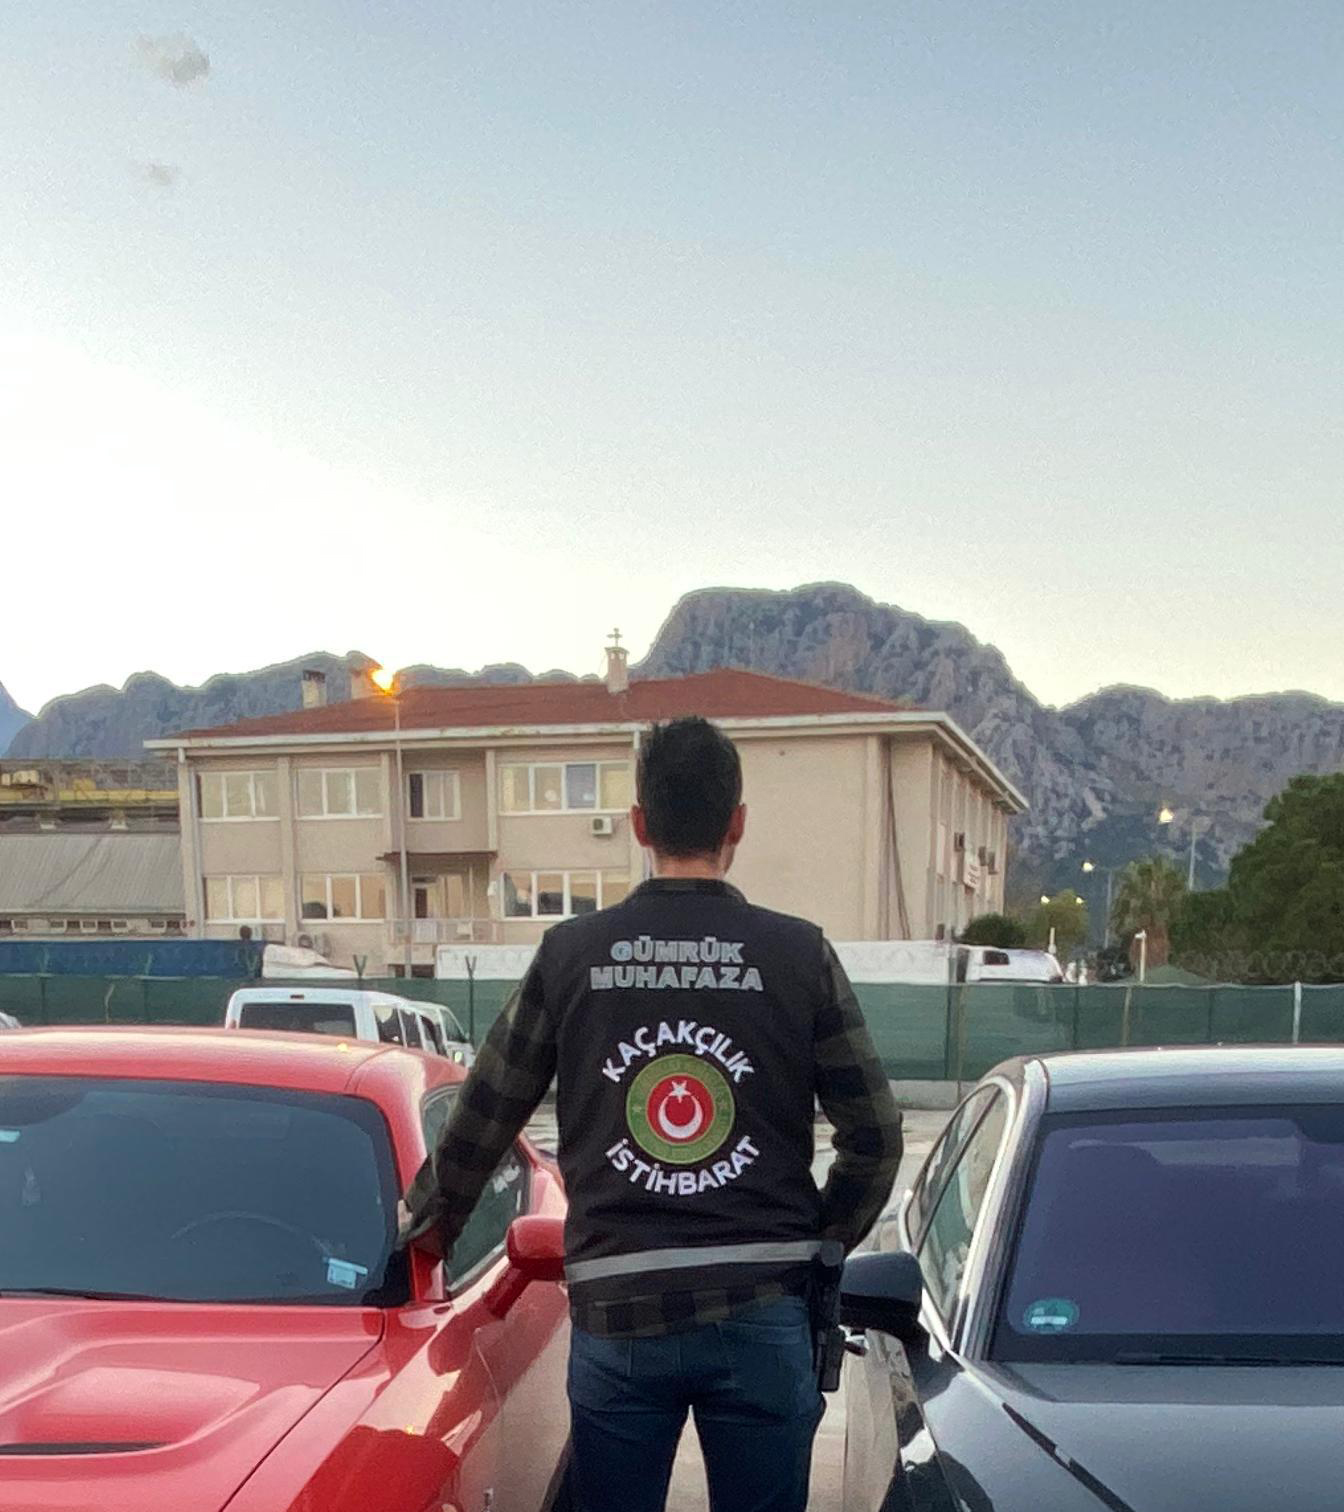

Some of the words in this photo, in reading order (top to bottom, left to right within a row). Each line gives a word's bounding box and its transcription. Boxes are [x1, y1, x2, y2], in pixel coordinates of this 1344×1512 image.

[610, 935, 744, 963] GÜMRÜK
[590, 966, 764, 992] MUHAFAZA
[602, 1020, 755, 1084] KAÇAKÇILIK
[605, 1135, 761, 1196] İSTİHBARAT
